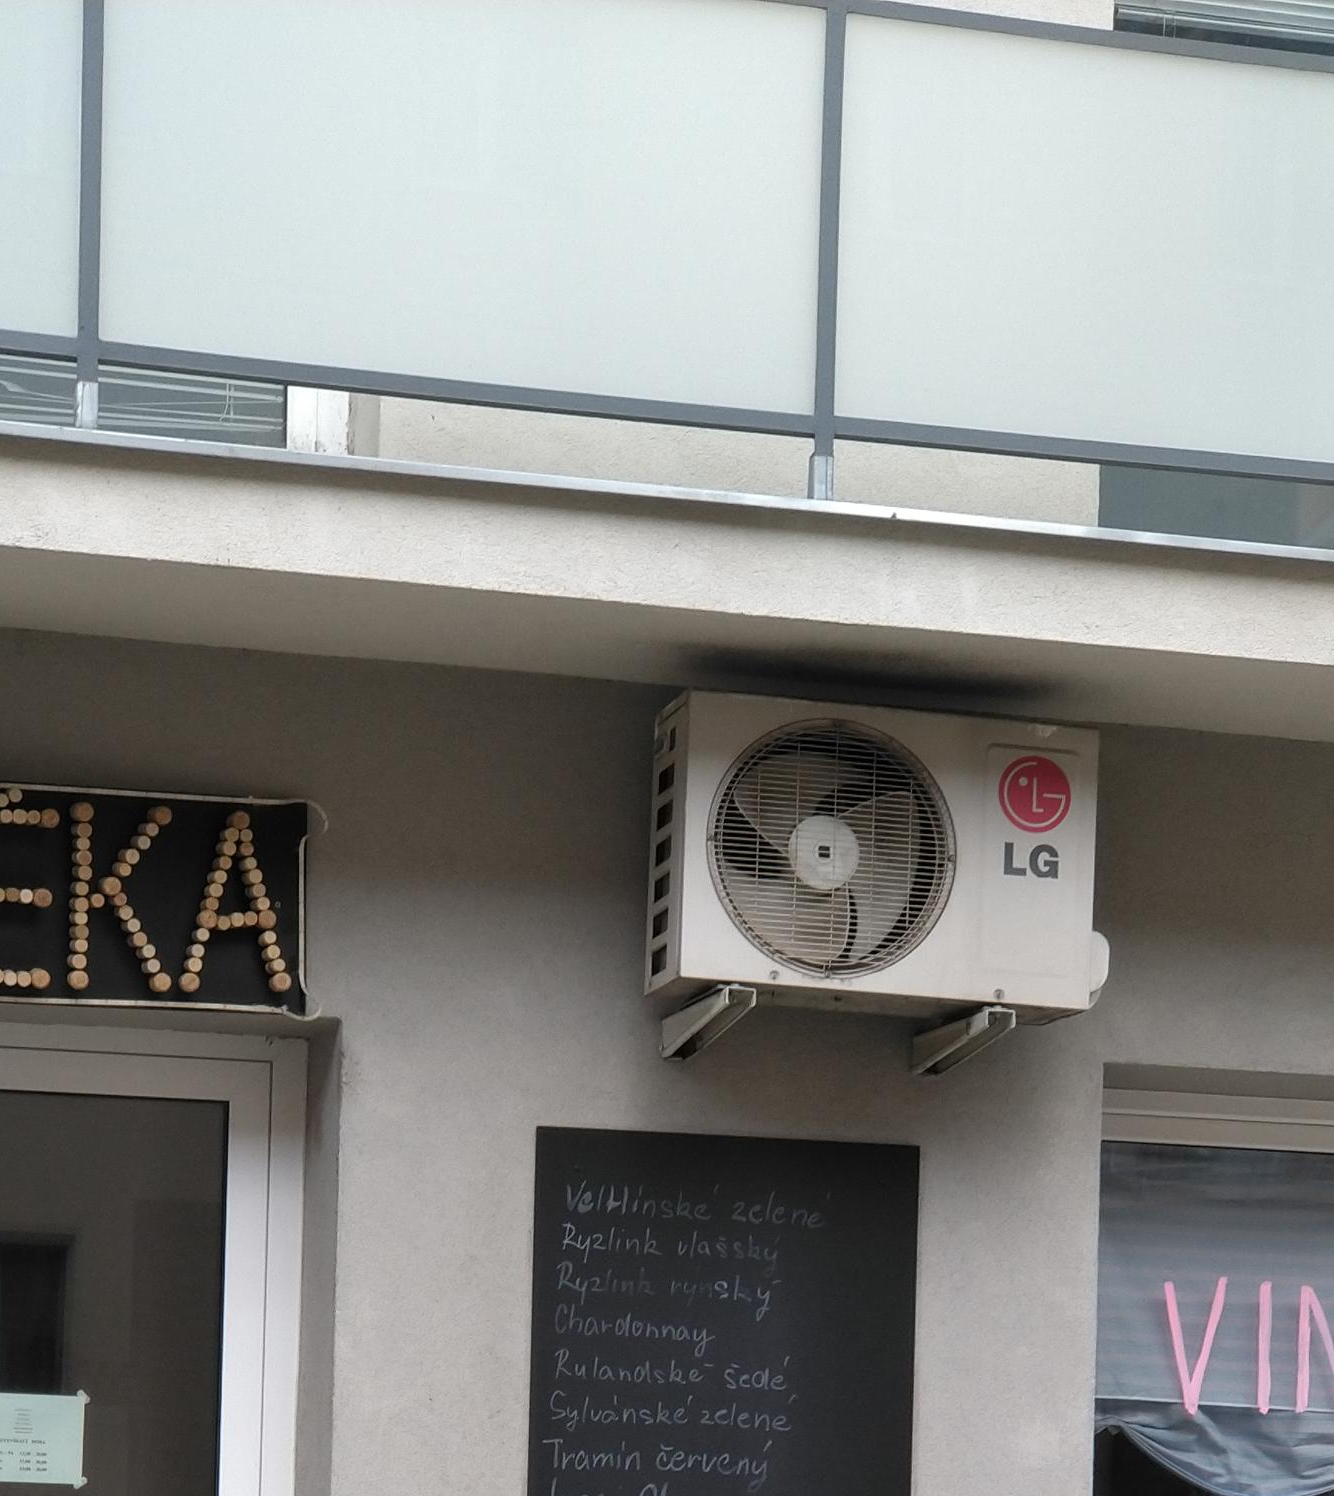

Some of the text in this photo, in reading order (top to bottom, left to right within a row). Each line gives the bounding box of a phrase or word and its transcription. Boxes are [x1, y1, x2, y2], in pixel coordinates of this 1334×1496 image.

[1003, 841, 1060, 880] LG
[732, 1192, 831, 1229] zelené
[562, 1222, 663, 1263] Ryzlink
[556, 1261, 654, 1304] Ryzlink
[555, 1303, 715, 1357] Chardonnay
[555, 1348, 790, 1390] Rulandské šedé
[550, 1391, 797, 1432] Sylvánské zelené
[542, 1438, 773, 1493] Tramín červený
